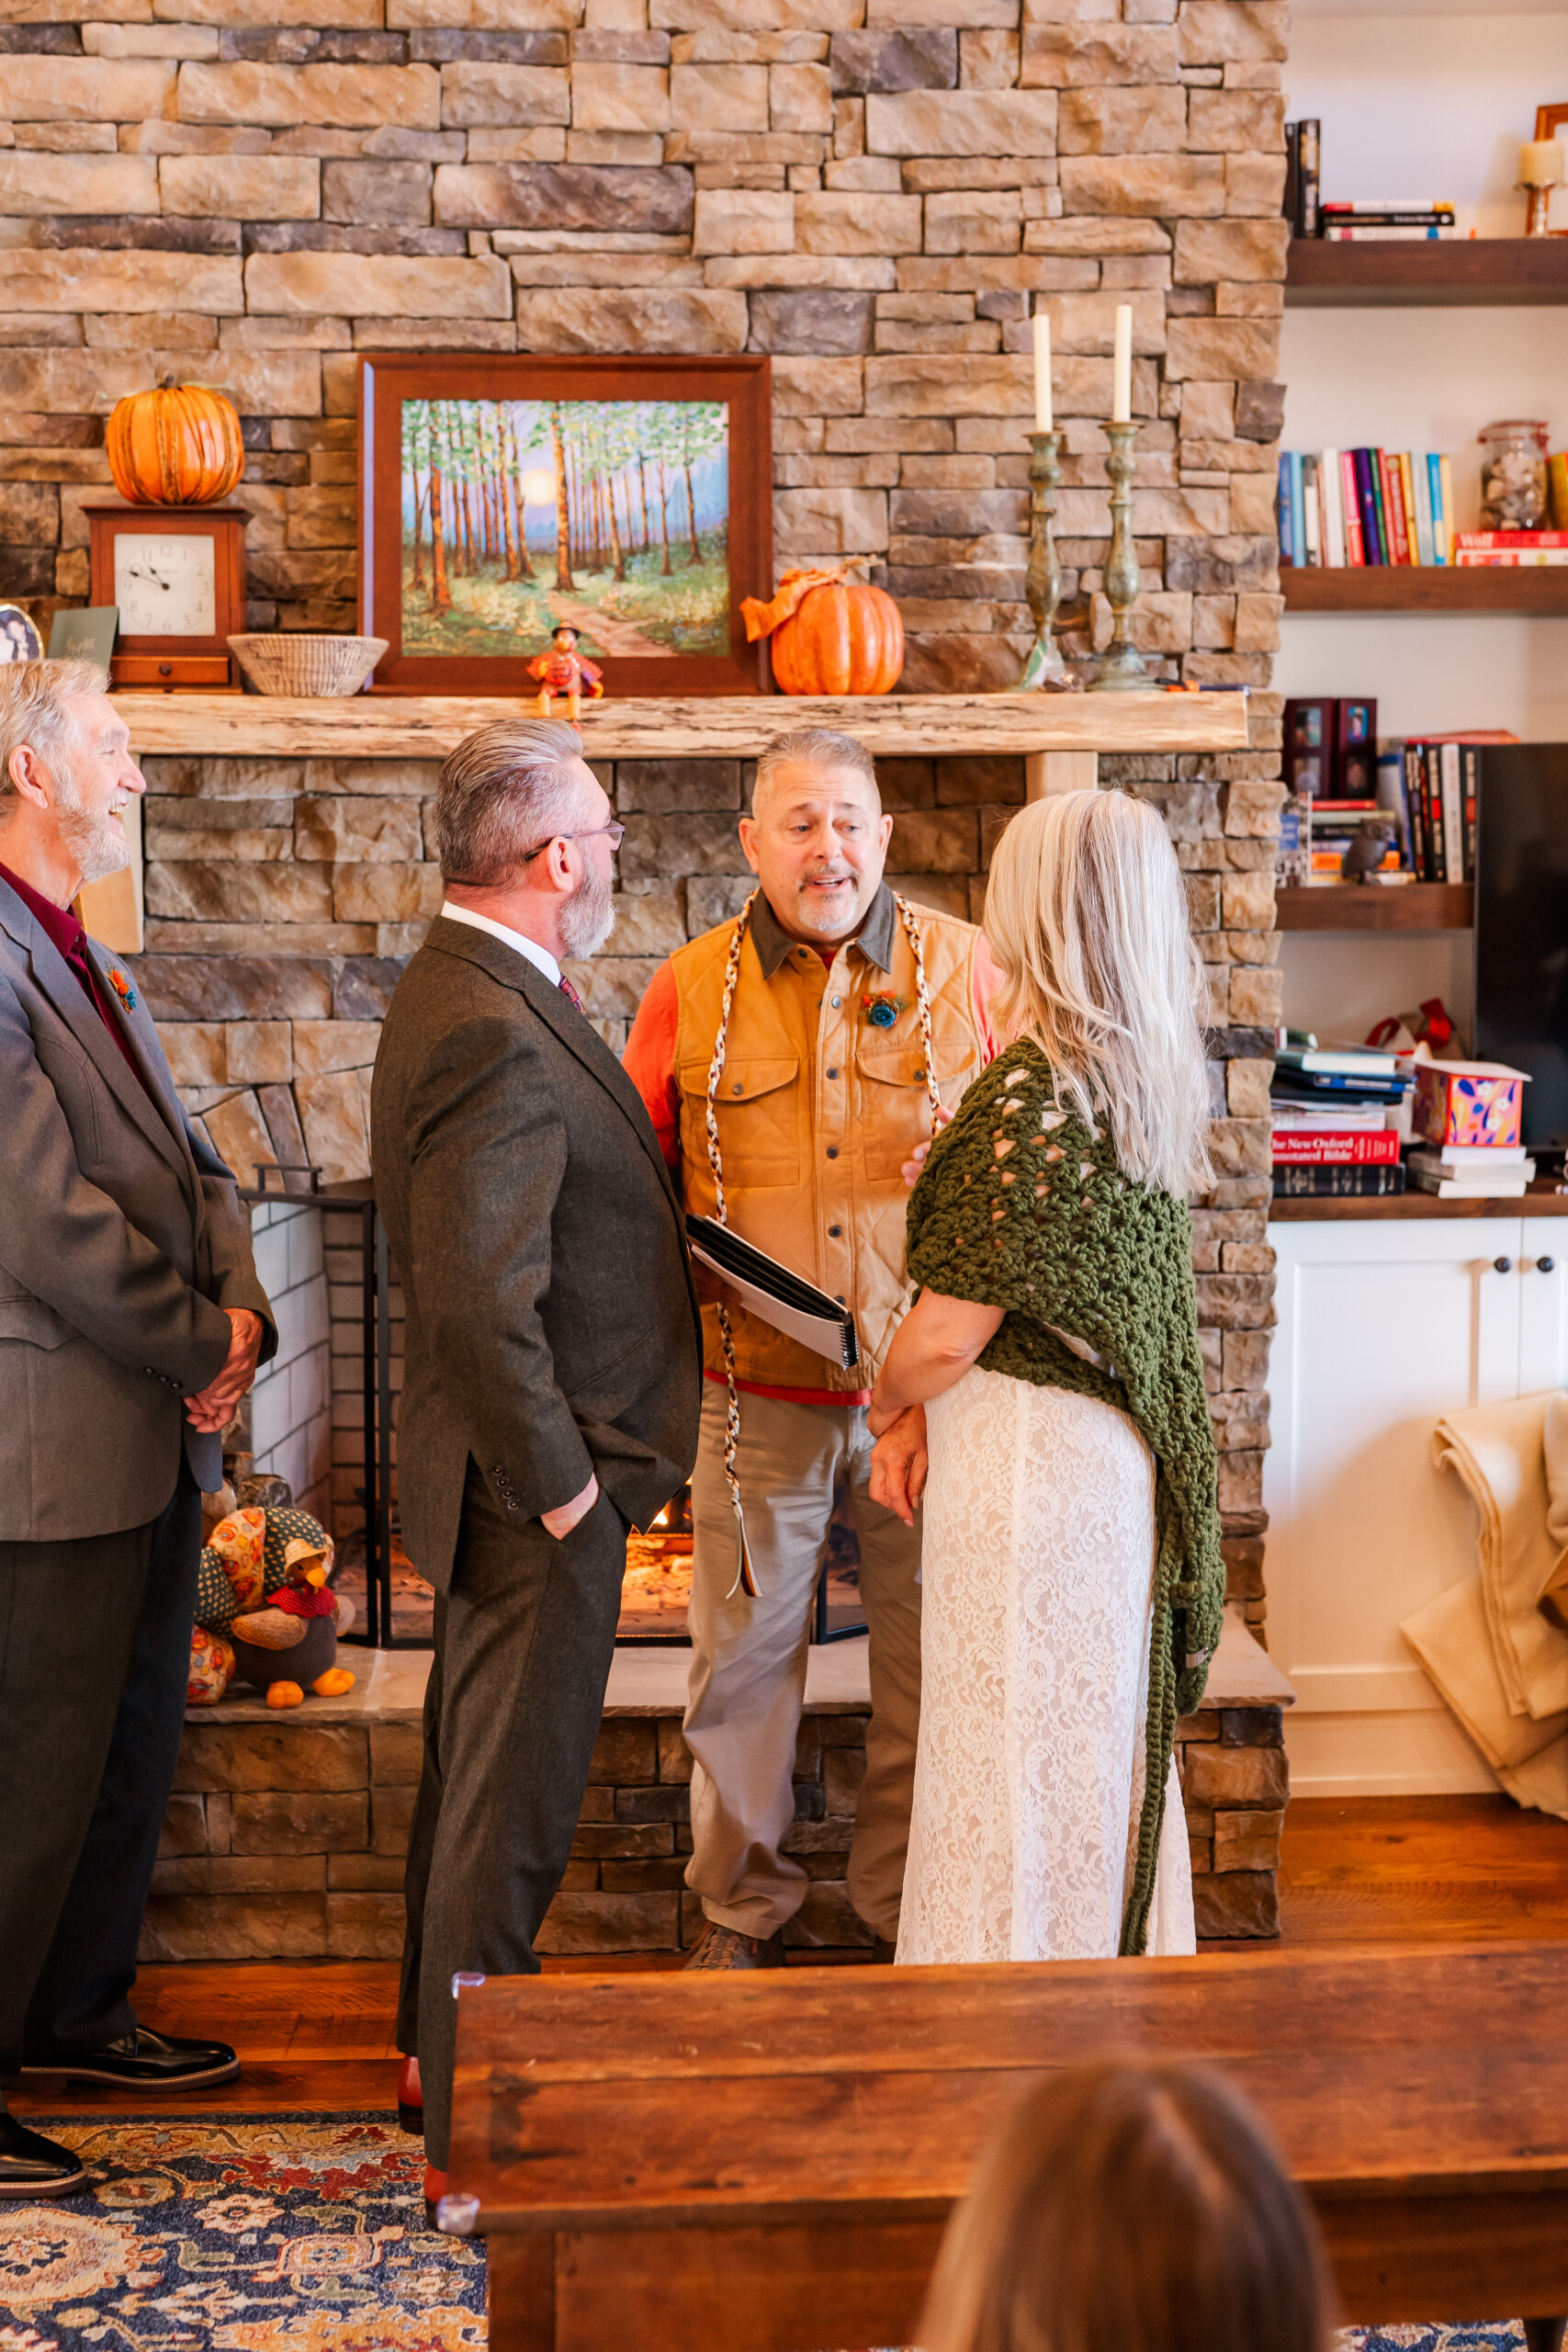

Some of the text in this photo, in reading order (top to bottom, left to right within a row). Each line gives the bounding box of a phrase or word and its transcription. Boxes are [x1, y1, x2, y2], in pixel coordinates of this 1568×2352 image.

[141, 549, 152, 562] 11
[160, 543, 173, 558] 12
[196, 562, 205, 577] 2
[123, 581, 132, 594] 9
[202, 582, 210, 596] 3
[130, 600, 139, 613] 8
[196, 601, 204, 614] 4
[144, 613, 153, 628] 7
[163, 617, 172, 632] 6
[183, 614, 191, 626] 5
[1271, 1138, 1286, 1150] he
[1287, 1137, 1312, 1150] New
[1313, 1136, 1354, 1149] Oxford
[1272, 1149, 1353, 1161] nnotated Bible
